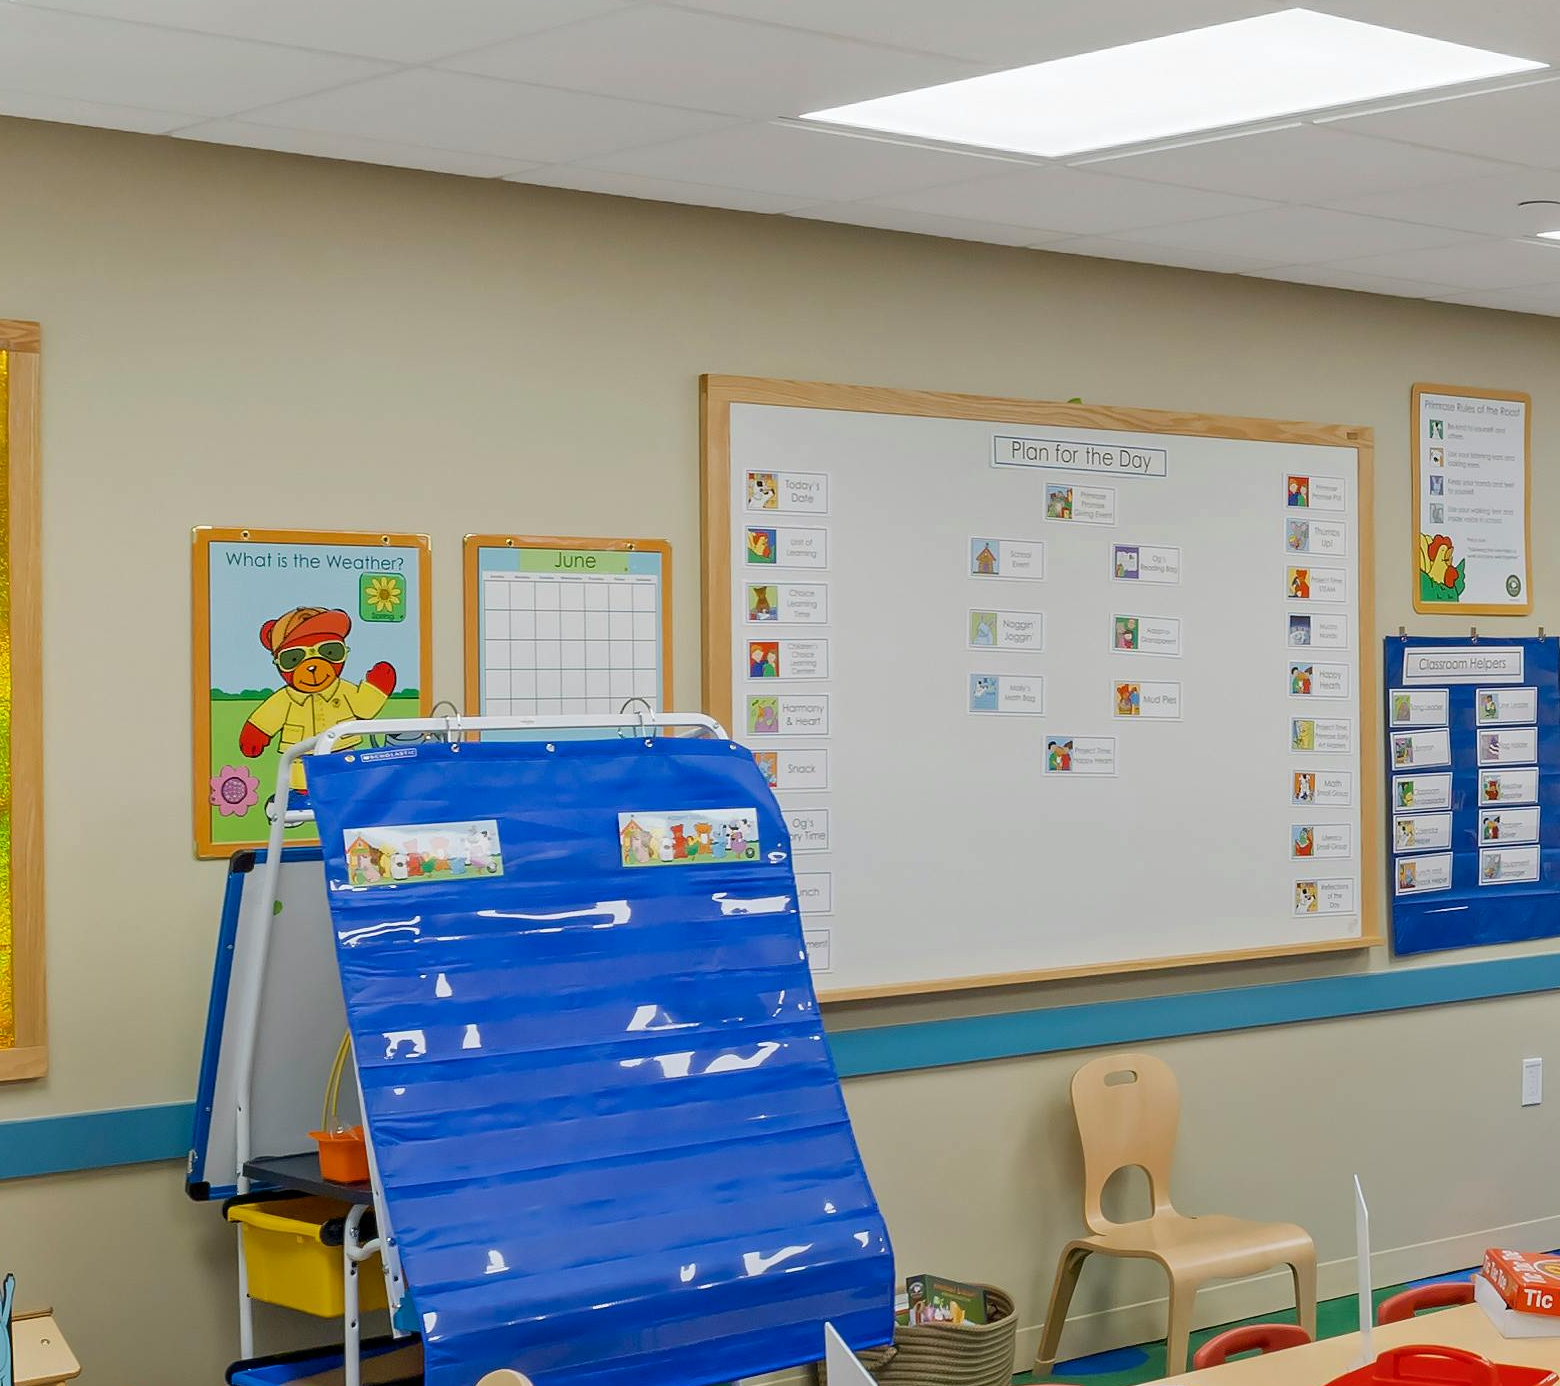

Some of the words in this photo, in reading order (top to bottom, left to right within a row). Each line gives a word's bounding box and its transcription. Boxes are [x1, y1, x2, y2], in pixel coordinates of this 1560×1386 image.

[1425, 400, 1455, 412] Primrose
[1457, 403, 1475, 414] Rules
[1477, 405, 1485, 413] of
[1486, 406, 1499, 415] the
[1011, 441, 1049, 462] Plan
[1055, 444, 1079, 463] for
[1086, 447, 1114, 467] the
[1119, 450, 1152, 473] Day
[785, 479, 820, 491] Today's
[791, 493, 814, 503] Date
[805, 538, 813, 546] of
[786, 550, 817, 560] Learning
[1010, 550, 1032, 559] School
[226, 552, 272, 567] What
[277, 553, 288, 567] is
[293, 553, 321, 569] the
[326, 554, 404, 571] Weather?
[554, 552, 597, 569] June
[1012, 560, 1030, 568] Event
[1152, 555, 1167, 565] Og's
[1140, 563, 1165, 574] Reading
[1165, 565, 1178, 574] Bag
[788, 589, 816, 597] Choice
[787, 600, 818, 610] Learning
[1002, 619, 1036, 631] Noggin'
[1003, 632, 1034, 644] Joggin'
[790, 660, 817, 668] Learning
[1419, 658, 1468, 671] Classroom
[1469, 658, 1507, 671] Helpers
[1320, 671, 1341, 680] Happy
[1004, 694, 1021, 702] Math
[1022, 694, 1036, 704] Bag
[1143, 695, 1161, 705] Mud
[1162, 695, 1177, 705] Pies
[782, 704, 824, 714] Harmony
[786, 717, 793, 726] &
[795, 716, 821, 726] Heart
[788, 764, 817, 774] Snack
[1324, 779, 1343, 788] Math
[792, 818, 814, 830] Og's
[805, 831, 826, 841] Time
[1524, 1288, 1553, 1308] Tic
